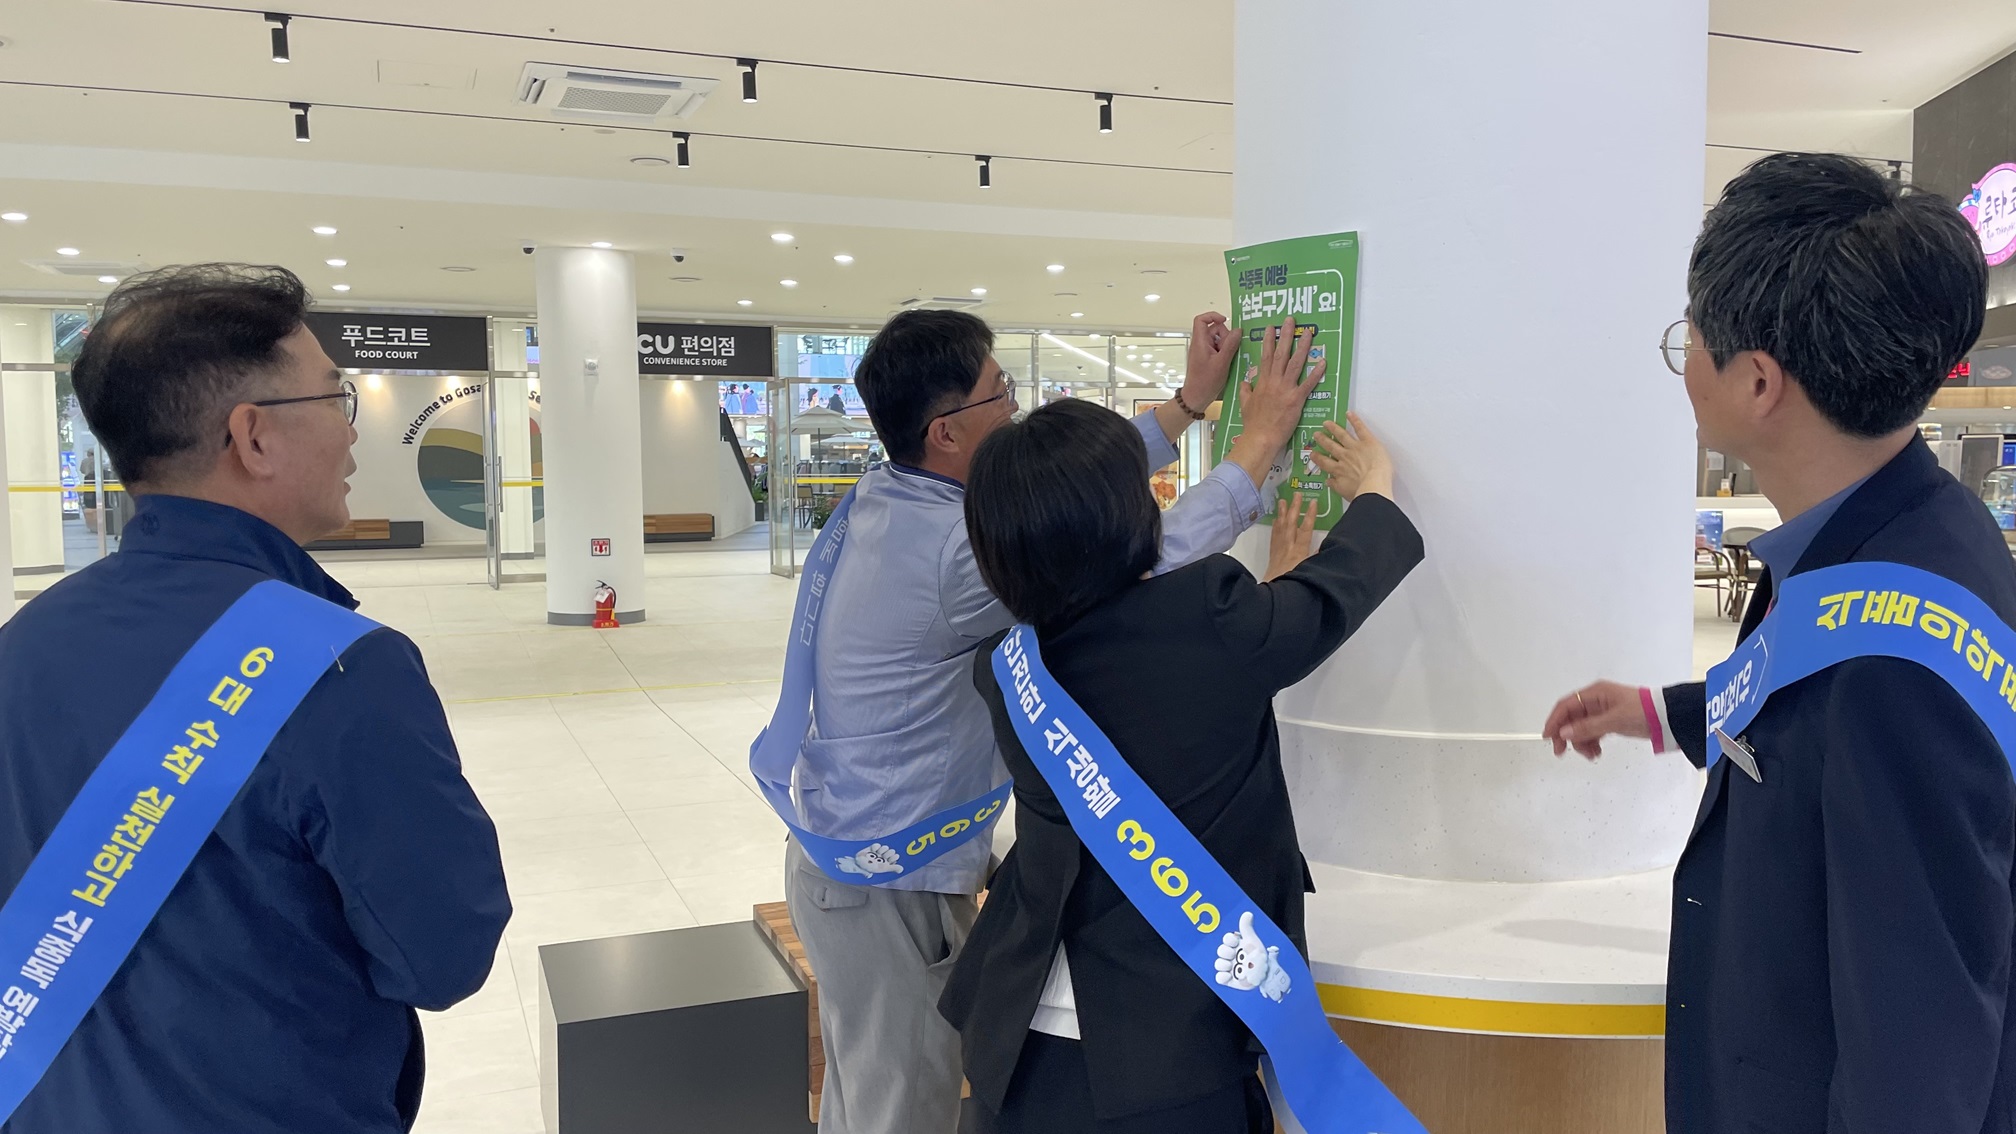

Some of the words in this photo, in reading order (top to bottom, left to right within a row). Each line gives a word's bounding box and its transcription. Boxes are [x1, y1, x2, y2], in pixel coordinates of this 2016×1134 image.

[1239, 267, 1263, 290] 식중독
[1265, 264, 1288, 286] 예방
[341, 325, 431, 347] 푸드코트
[355, 350, 383, 359] FOOD
[385, 350, 419, 360] COURT
[637, 333, 675, 355] CU
[680, 335, 735, 357] 편의점
[643, 356, 700, 366] CONVENIENCE
[701, 358, 728, 367] STORE
[402, 399, 441, 446] Welcome
[439, 392, 453, 406] to
[528, 390, 541, 405] Se
[208, 647, 274, 715] 6대
[163, 720, 218, 784] 수칙
[1002, 628, 1047, 725] 안전한
[1043, 716, 1121, 820] 식생활
[1116, 820, 1220, 934] 365
[73, 786, 175, 907] 실천하고
[907, 799, 1002, 856] 365
[20, 910, 94, 990] 식중독
